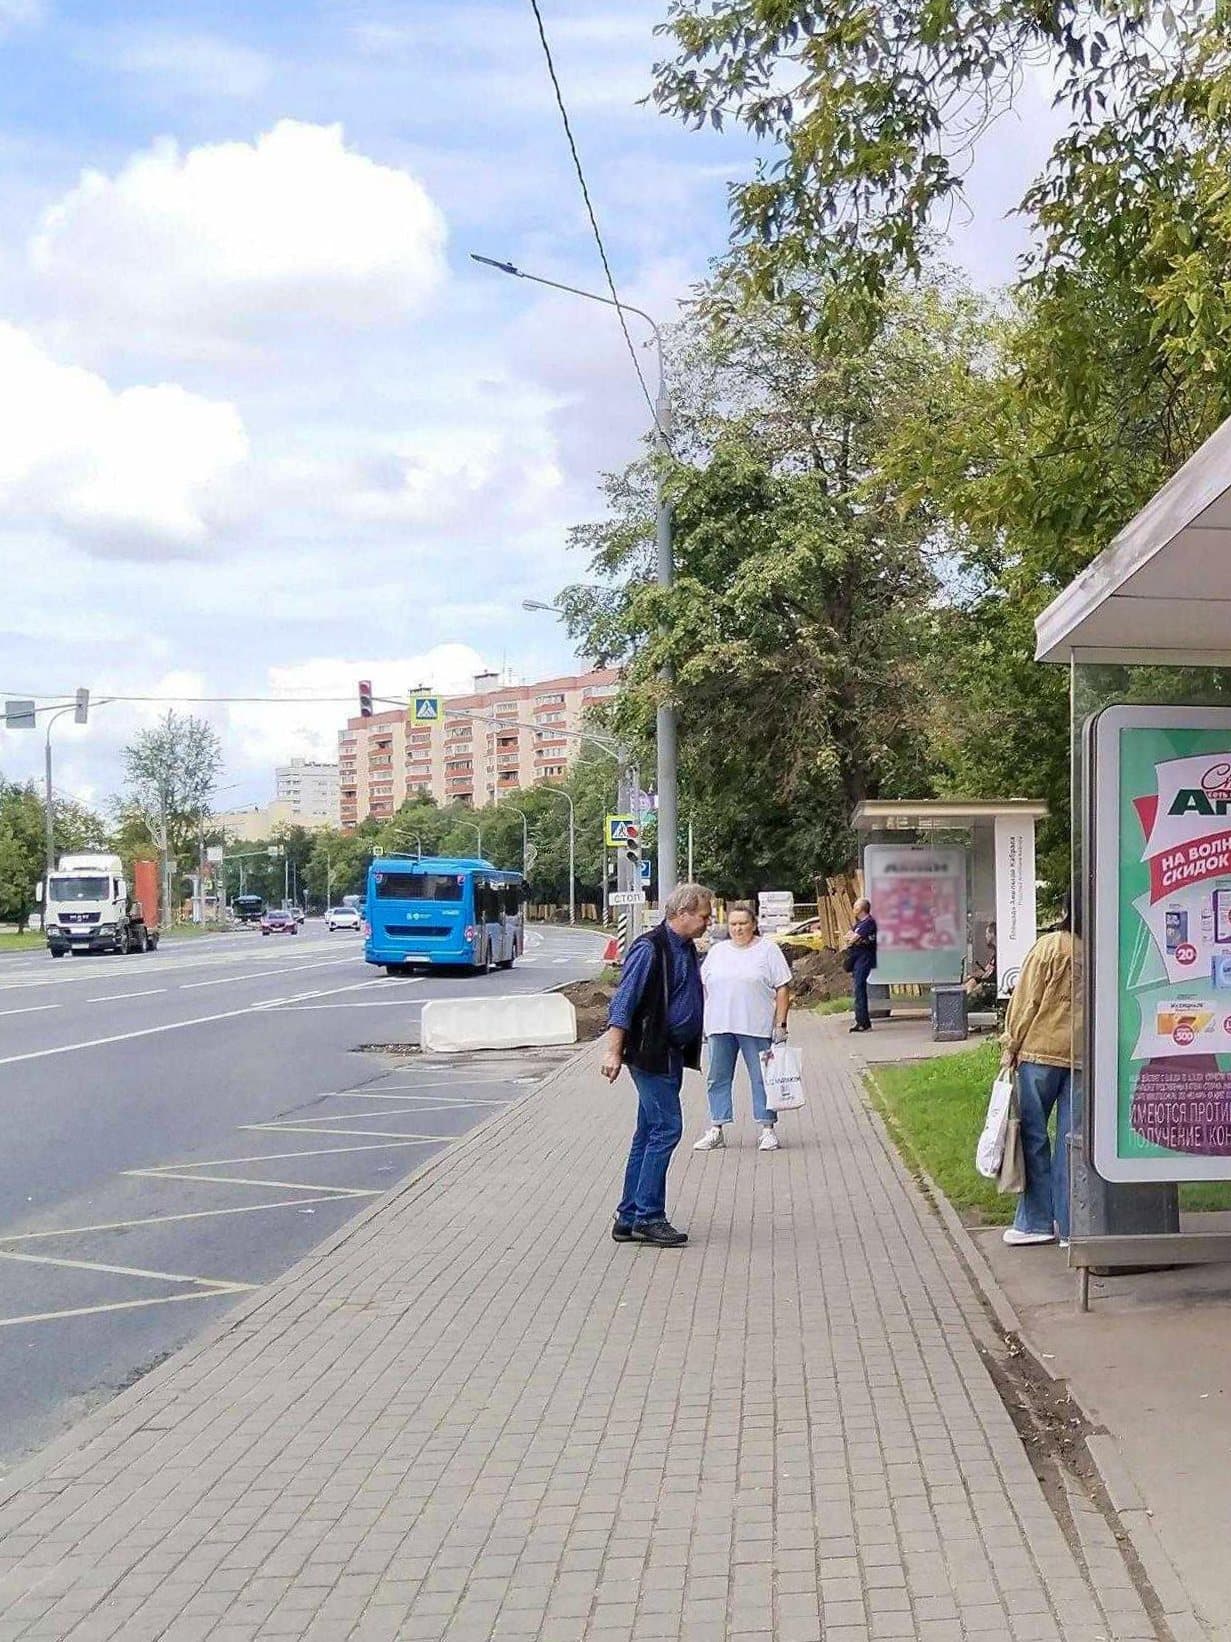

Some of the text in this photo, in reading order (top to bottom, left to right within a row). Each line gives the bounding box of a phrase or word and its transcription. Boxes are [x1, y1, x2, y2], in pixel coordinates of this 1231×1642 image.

[1161, 852, 1186, 872] НА
[1162, 853, 1230, 886] СКИДОК
[614, 894, 641, 903] СТОП
[1129, 1102, 1187, 1124] ИМЕЮТСЯ
[1129, 1126, 1201, 1148] ПОЛУЧЕНИЕ
